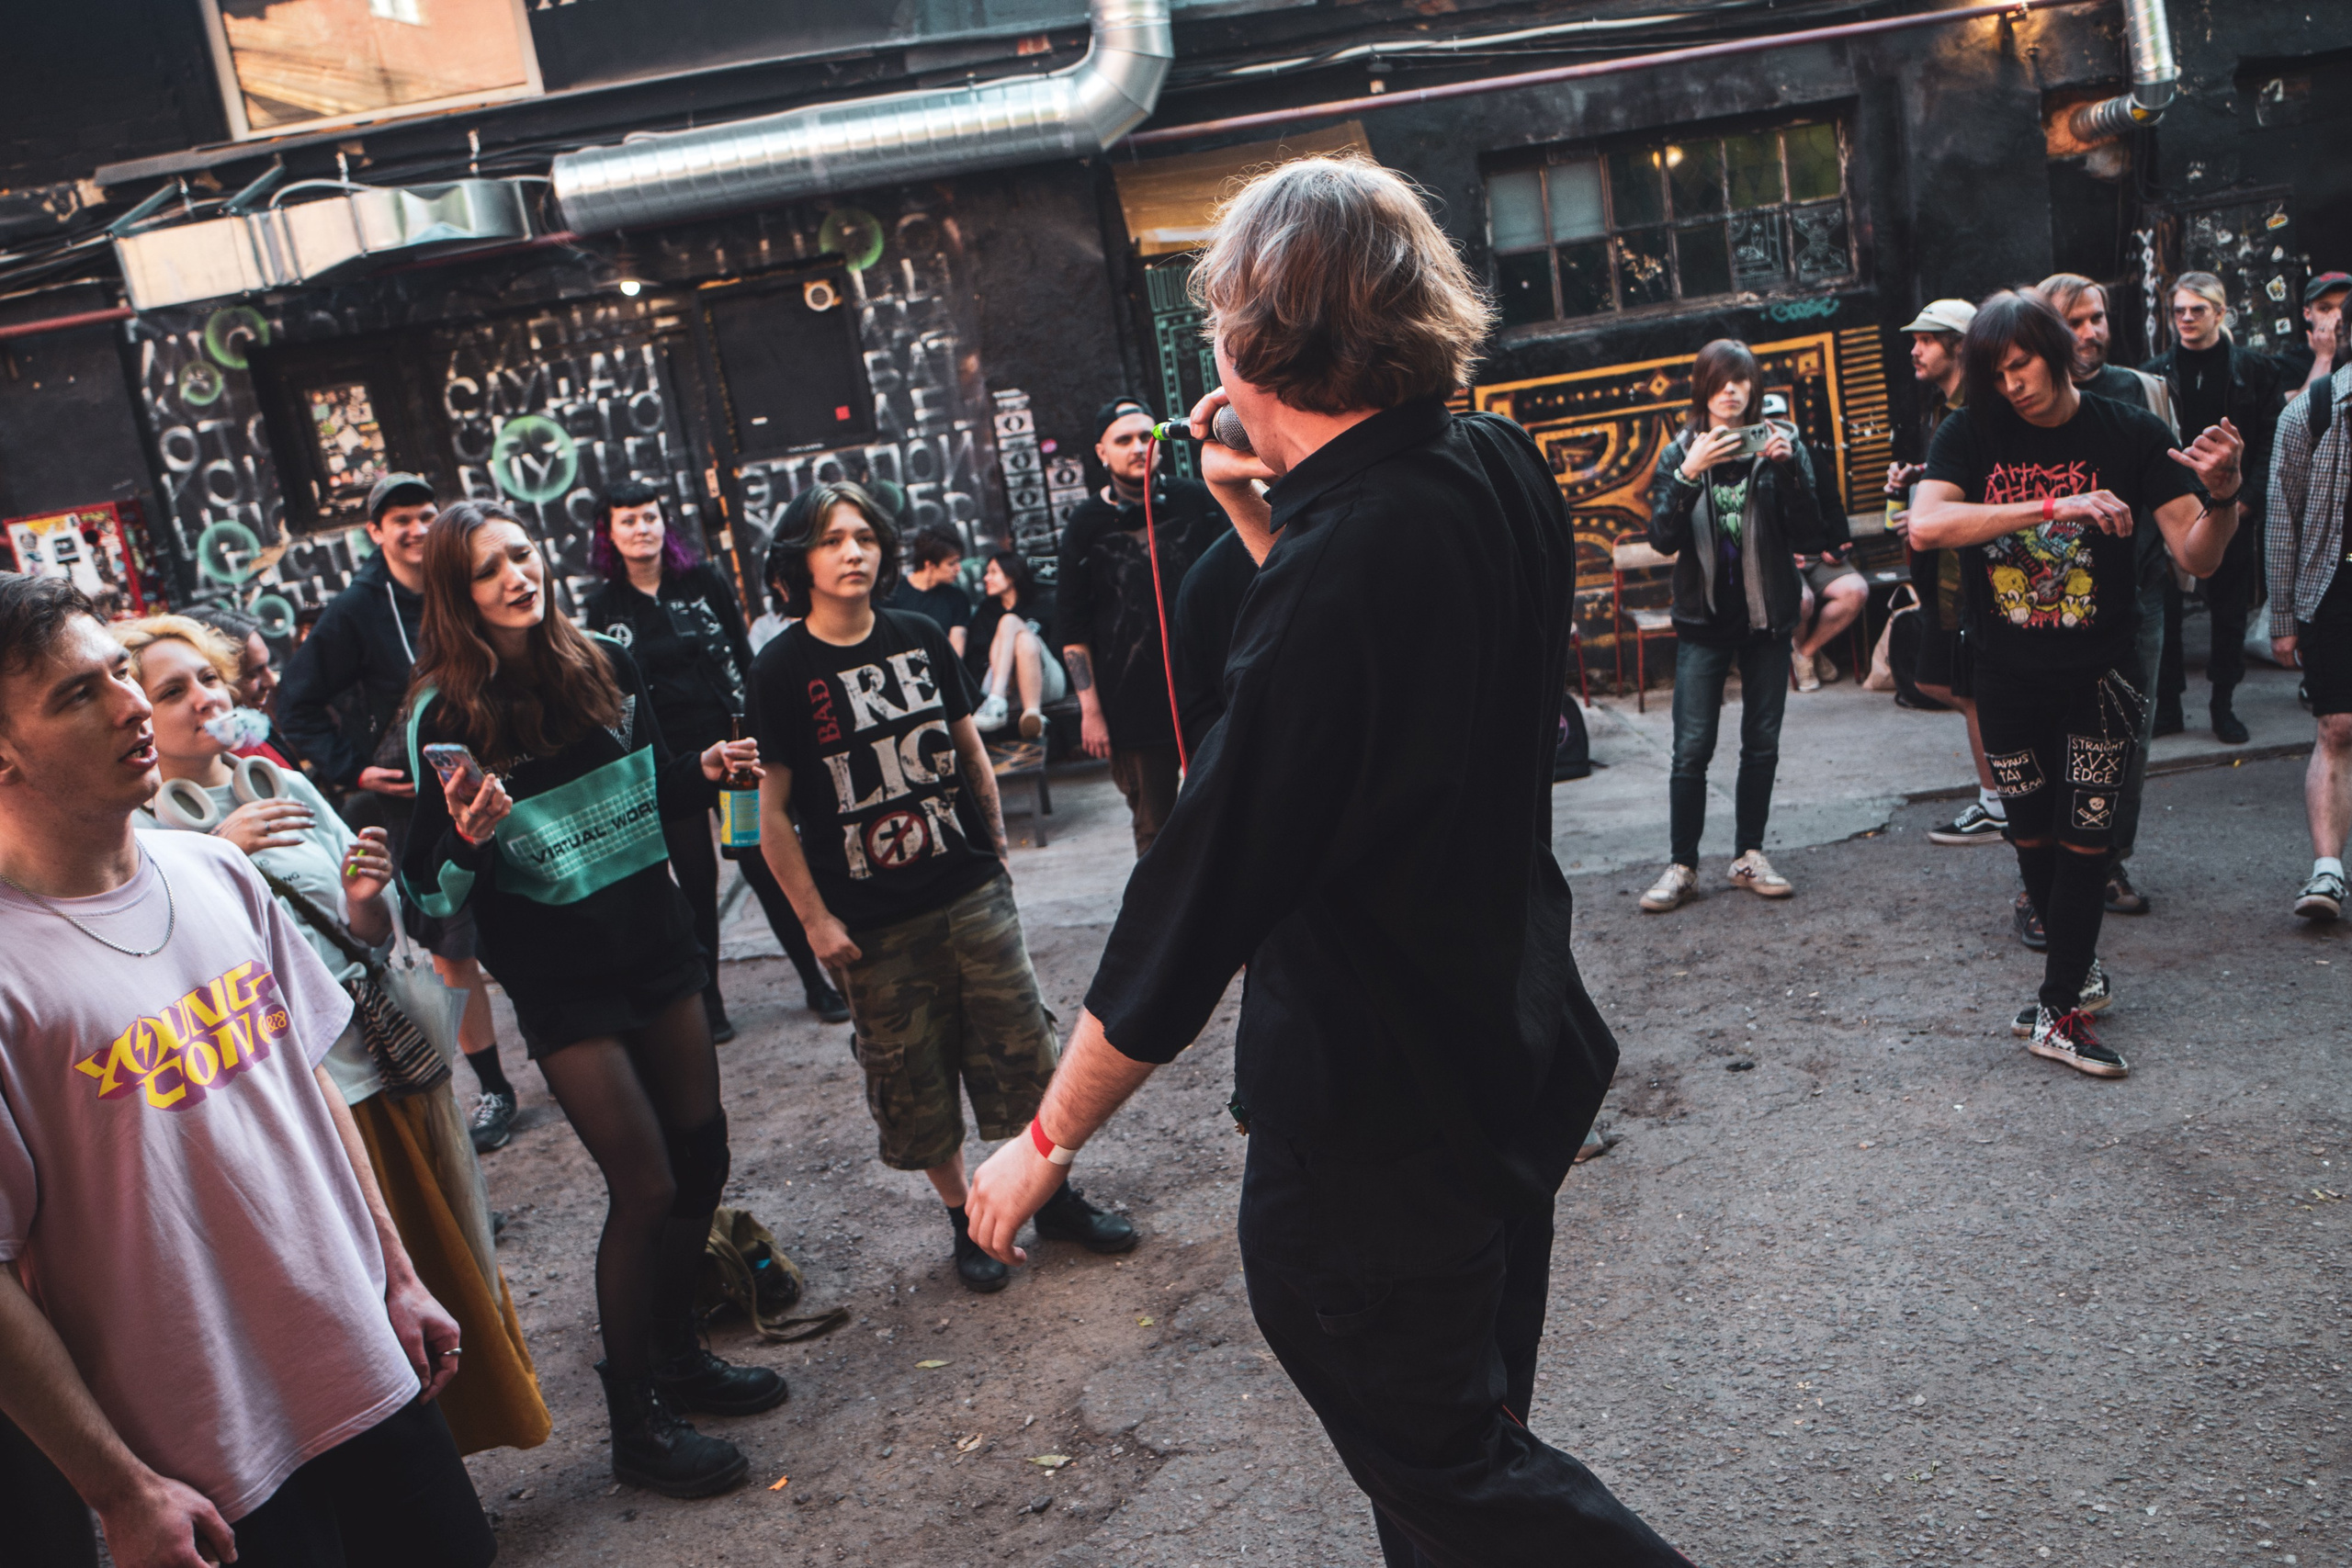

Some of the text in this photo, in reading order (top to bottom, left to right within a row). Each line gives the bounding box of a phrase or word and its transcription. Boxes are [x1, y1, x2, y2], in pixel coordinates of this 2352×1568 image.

[808, 678, 842, 746] BAD
[837, 648, 944, 732] RE
[2073, 767, 2114, 784] EDGE
[530, 829, 607, 865] VIRTUAL
[74, 960, 273, 1099] YOUNG
